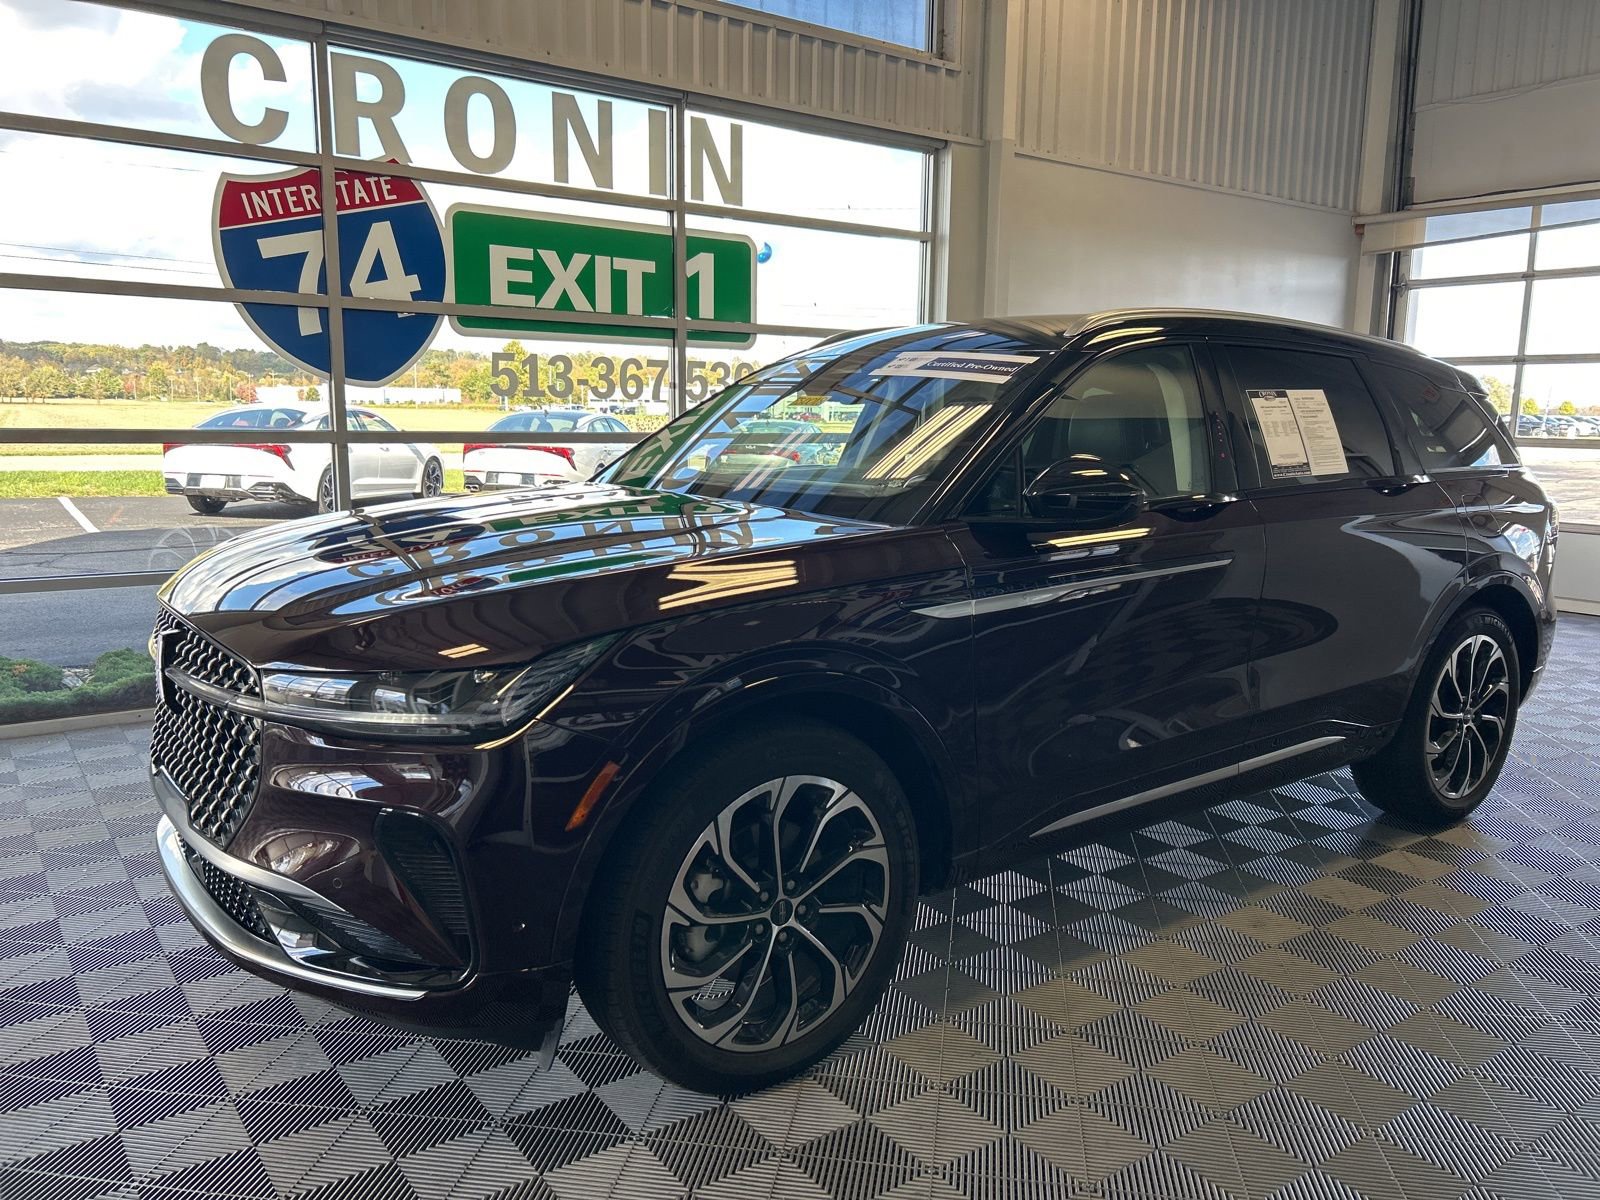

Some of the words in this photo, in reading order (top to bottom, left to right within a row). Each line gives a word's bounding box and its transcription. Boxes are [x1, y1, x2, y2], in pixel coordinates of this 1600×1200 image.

[200, 34, 744, 207] CRONIN
[240, 176, 398, 219] INTERTATE
[258, 221, 423, 337] 74
[488, 244, 656, 316] EXIT
[685, 252, 716, 319] 1
[927, 360, 963, 370] Certified
[964, 362, 1018, 373] Pre-Owned
